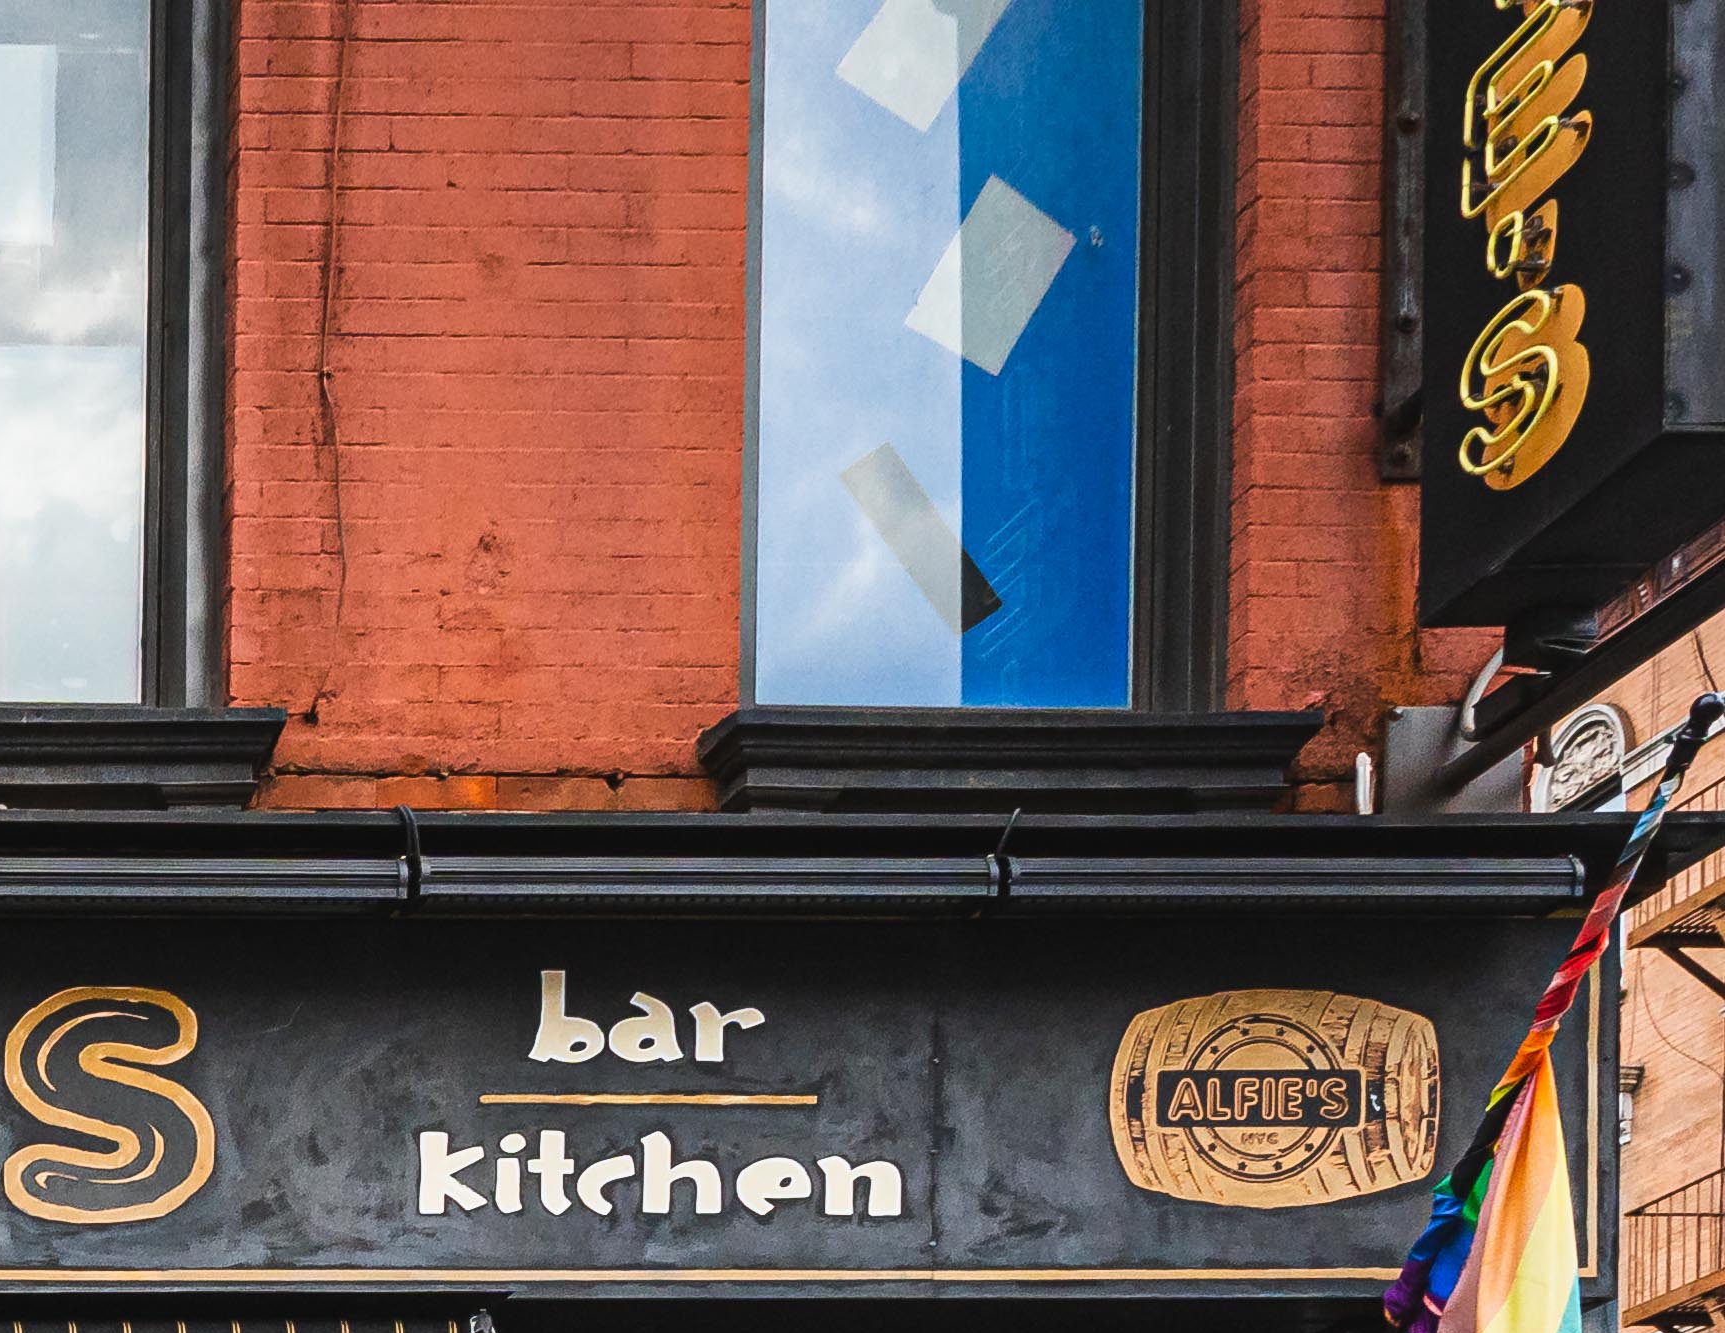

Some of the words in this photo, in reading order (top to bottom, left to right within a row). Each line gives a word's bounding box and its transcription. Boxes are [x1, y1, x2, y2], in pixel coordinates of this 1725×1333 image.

[527, 970, 767, 1064] bar
[1166, 1076, 1350, 1123] ALFIE'S
[416, 1130, 904, 1217] kitchen
